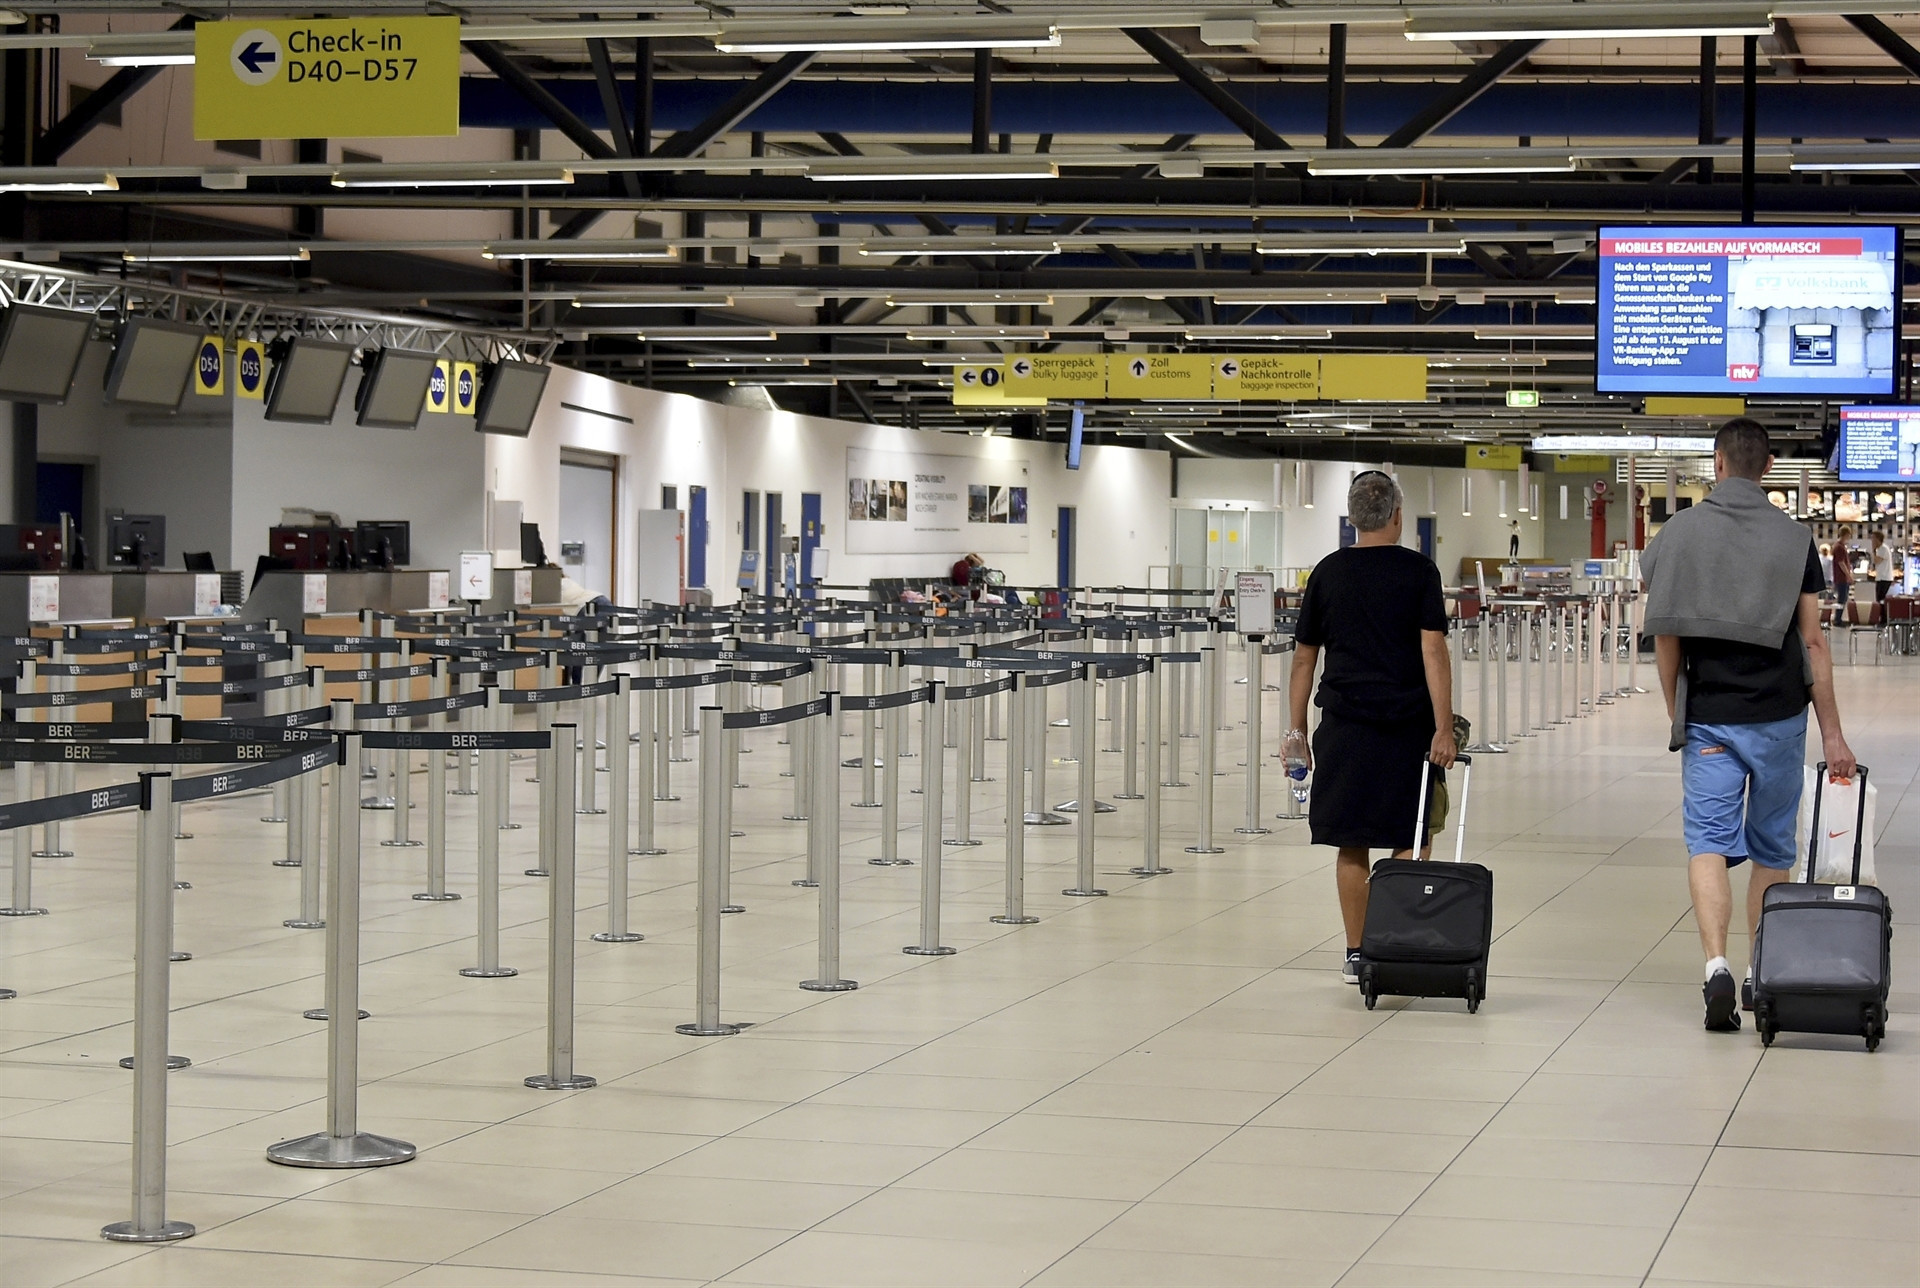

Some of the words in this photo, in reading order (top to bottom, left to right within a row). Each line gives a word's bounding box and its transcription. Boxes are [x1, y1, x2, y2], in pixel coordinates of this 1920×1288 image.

[288, 28, 402, 53] Check-in
[1615, 242, 1663, 253] MOBILES
[1666, 242, 1722, 253] BEZAHLEN
[1724, 242, 1747, 253] AUF
[1750, 242, 1820, 253] VORMARSCH
[1614, 262, 1634, 272] Nach
[1635, 262, 1650, 272] den
[1652, 262, 1694, 272] Sparkassen
[1696, 262, 1711, 272] und
[1614, 273, 1632, 282] dem
[1632, 273, 1652, 282] Start
[1670, 273, 1698, 283] Google
[1698, 273, 1712, 283] Pay
[1786, 277, 1869, 289] Volksbank
[1614, 283, 1640, 292] führen
[1657, 283, 1676, 292] auch
[1676, 283, 1689, 292] die
[200, 358, 220, 372] D54
[1033, 358, 1094, 370] Sperrgepäck
[1150, 358, 1169, 367] Zoll
[1241, 358, 1282, 369] Gepäck-
[242, 362, 260, 376] D55
[1150, 370, 1191, 378] customs
[1241, 370, 1311, 379] Nachkontrolle
[1733, 366, 1755, 379] ntv
[1033, 370, 1057, 380] bulky
[1060, 370, 1098, 380] luggage
[431, 379, 445, 392] D56
[460, 381, 472, 394] D57
[1240, 382, 1273, 391] baggage
[1275, 382, 1314, 390] inspection
[131, 688, 142, 698] BER
[52, 695, 65, 704] BER
[387, 705, 397, 715] BER
[287, 714, 298, 726] BER
[49, 725, 72, 736] BER
[283, 730, 308, 741] BER
[452, 735, 477, 746] BER
[65, 746, 90, 759] BER
[237, 745, 263, 759] BER
[302, 753, 315, 770] BER
[213, 776, 228, 792] BER
[92, 791, 109, 809] BER
